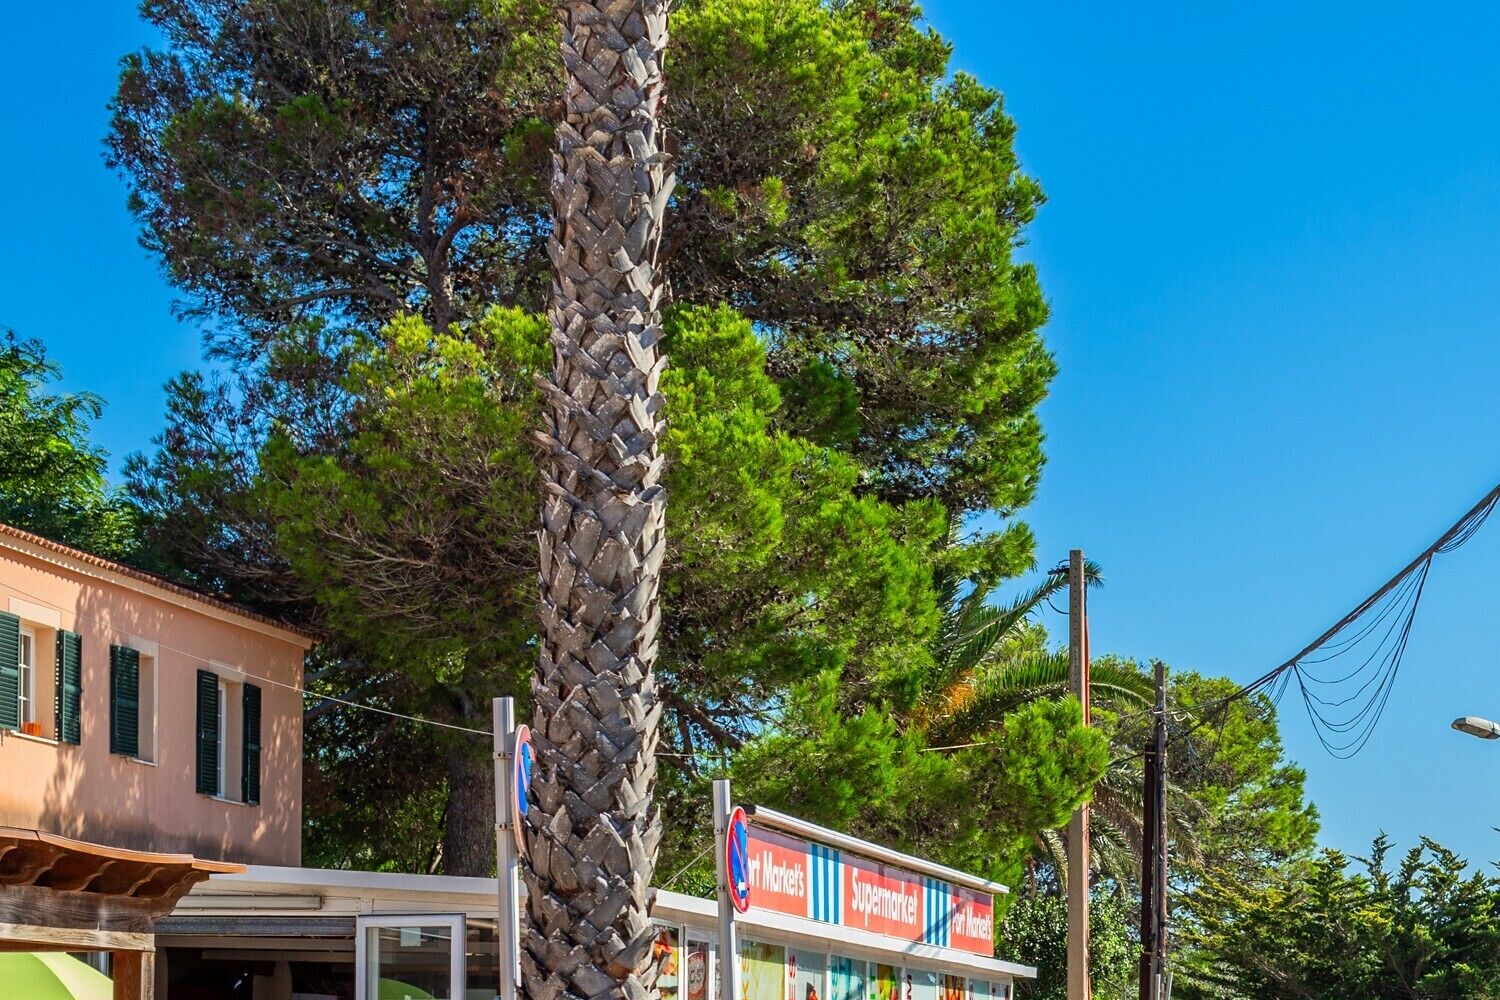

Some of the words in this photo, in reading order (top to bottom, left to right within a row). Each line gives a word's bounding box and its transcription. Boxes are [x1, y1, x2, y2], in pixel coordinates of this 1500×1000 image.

[763, 850, 804, 898] Market's
[852, 867, 918, 927] Supermarket
[952, 902, 965, 937] Port
